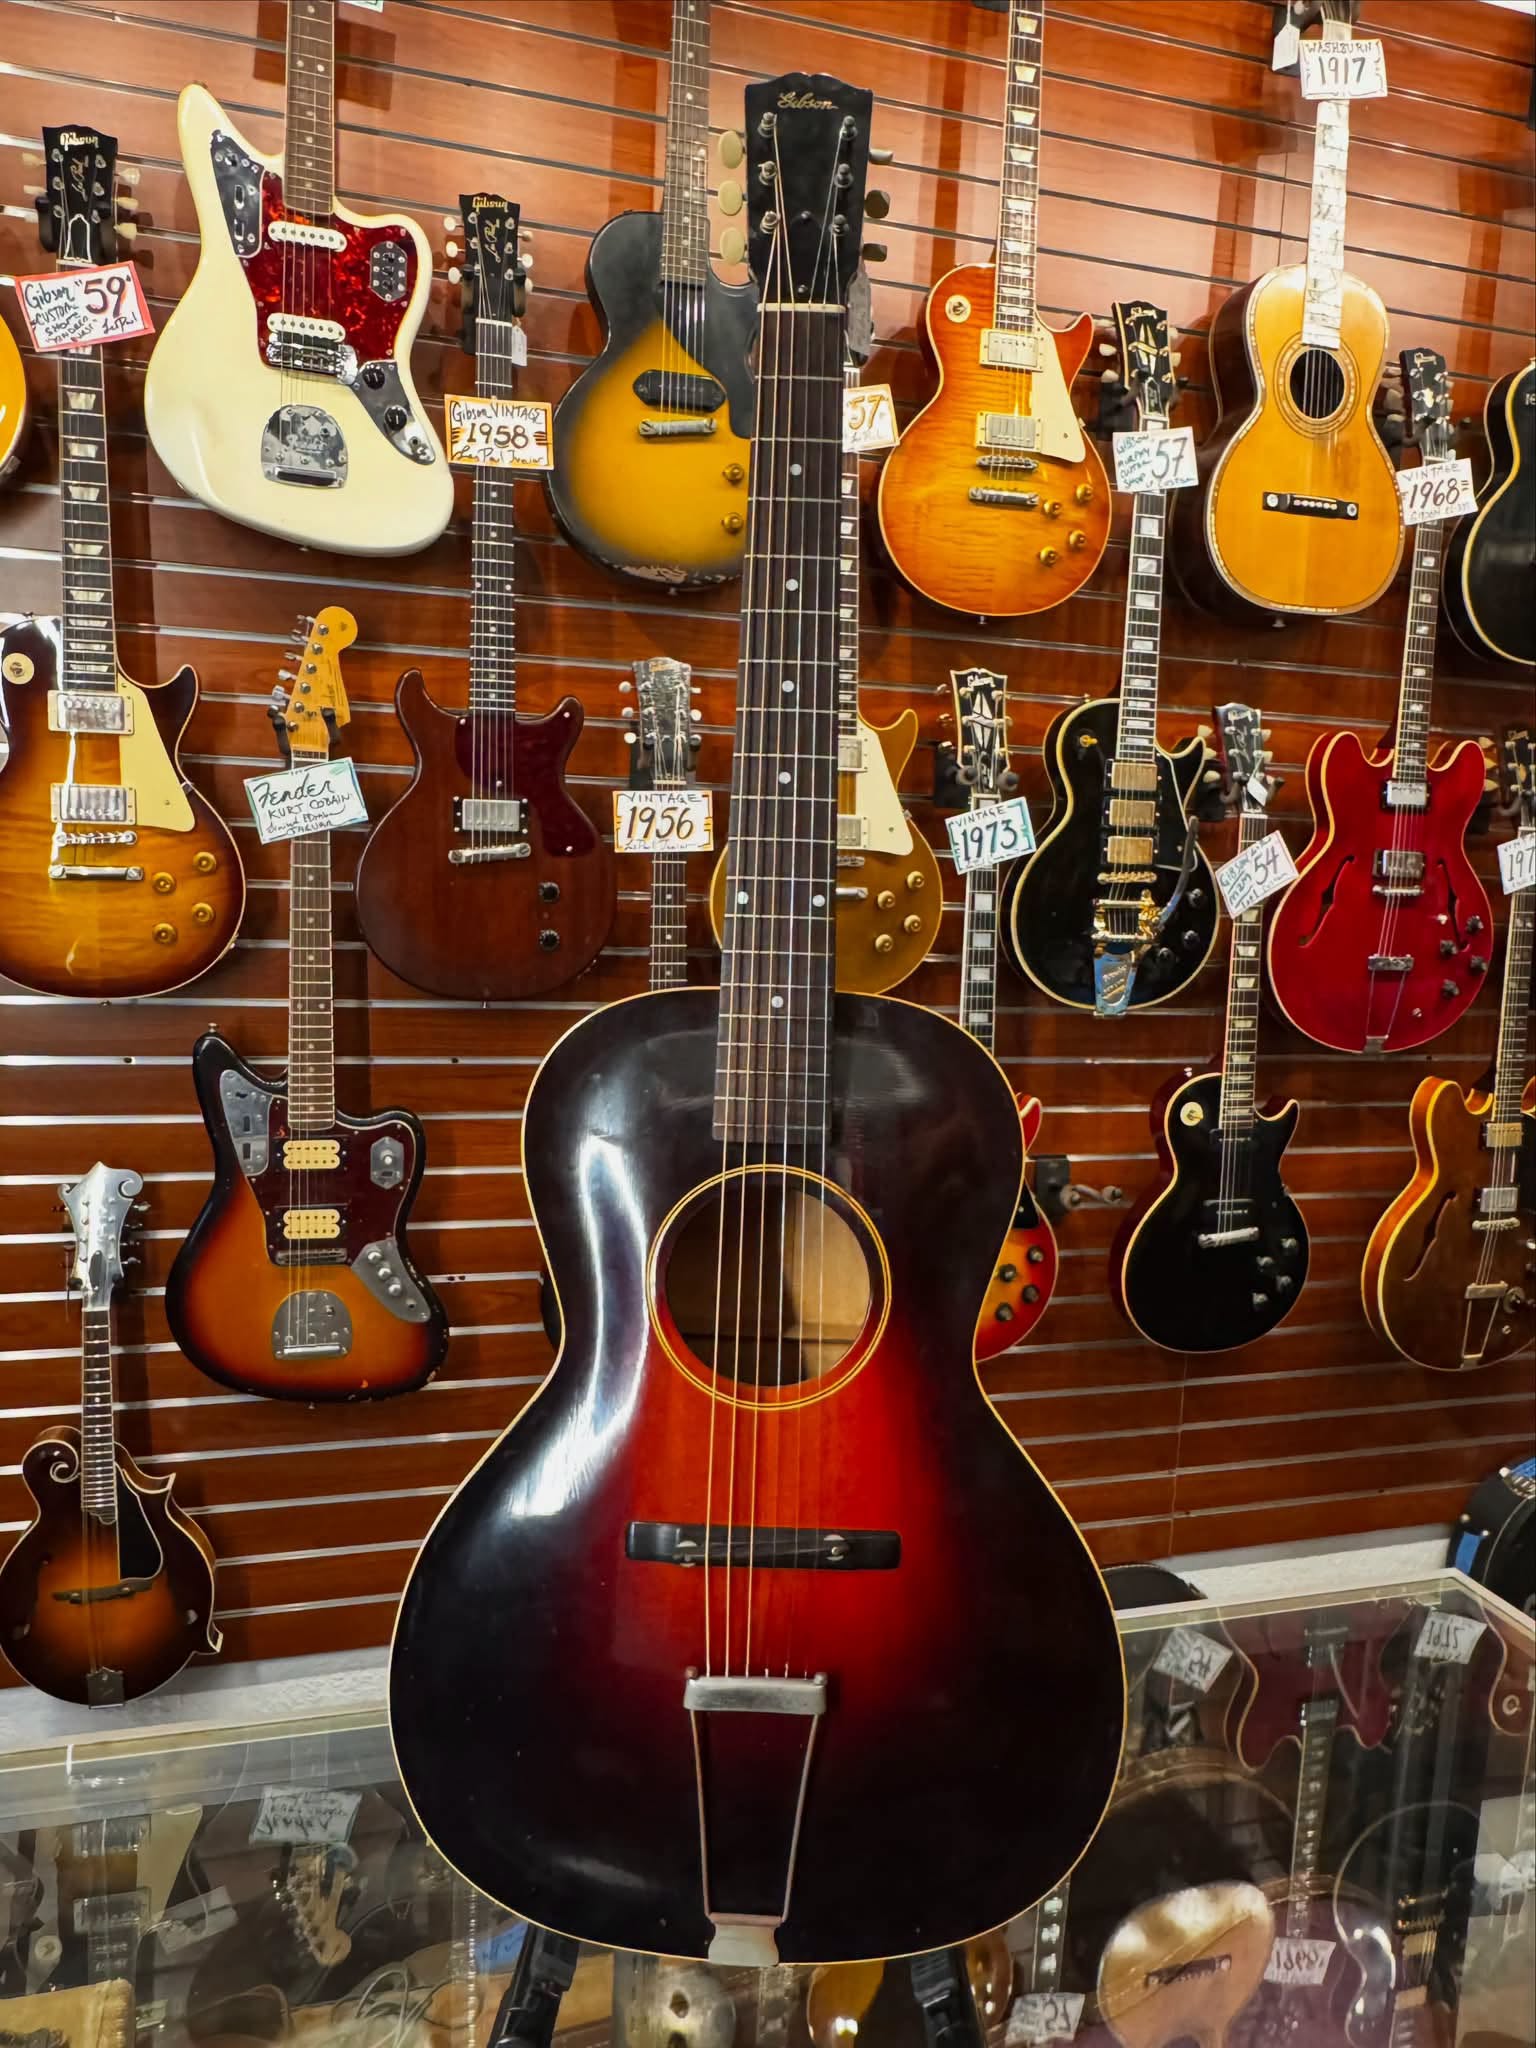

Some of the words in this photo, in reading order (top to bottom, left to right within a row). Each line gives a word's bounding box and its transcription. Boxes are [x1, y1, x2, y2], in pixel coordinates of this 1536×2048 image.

[1318, 56, 1366, 85] 1917
[777, 91, 839, 109] Gibson
[472, 196, 509, 213] Gibson
[25, 282, 75, 310] Gibson
[452, 400, 492, 426] Gibson
[466, 423, 528, 449] 1958
[1151, 436, 1188, 479] 57
[1409, 477, 1460, 509] 1968
[253, 773, 335, 809] Fender
[621, 791, 702, 805] VINTAGE
[267, 803, 303, 819] KURT
[627, 806, 694, 840] 1956
[955, 806, 1007, 827] VINTAGE
[961, 819, 1018, 861] 1973
[1254, 846, 1280, 886] 54
